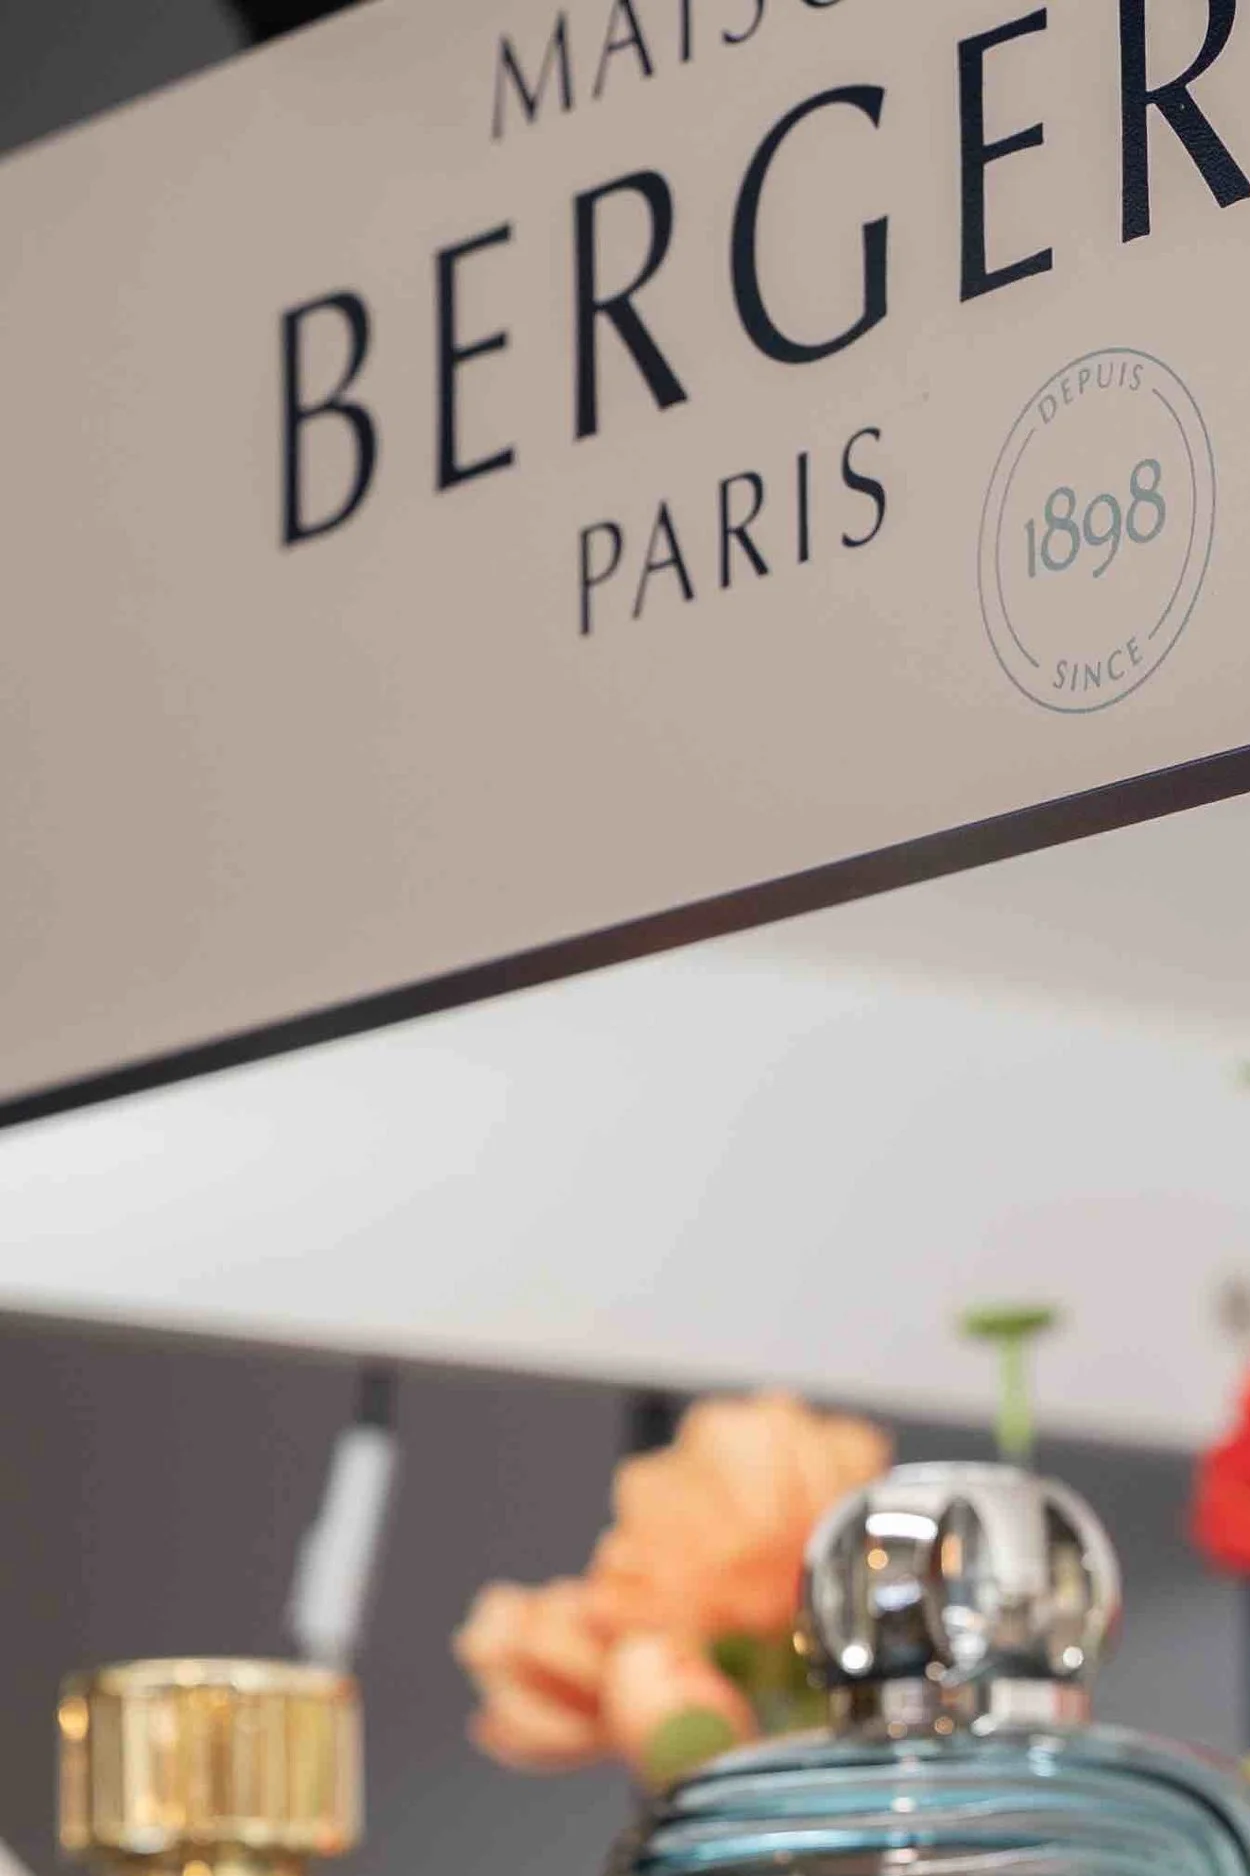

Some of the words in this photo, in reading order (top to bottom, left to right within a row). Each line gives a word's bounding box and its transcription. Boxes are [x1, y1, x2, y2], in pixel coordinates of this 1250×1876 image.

[491, 0, 838, 143] MAI
[1037, 361, 1144, 424] DEPUIS
[578, 427, 888, 638] PARIS
[1024, 458, 1166, 578] 1898
[1052, 636, 1144, 691] SINCE
